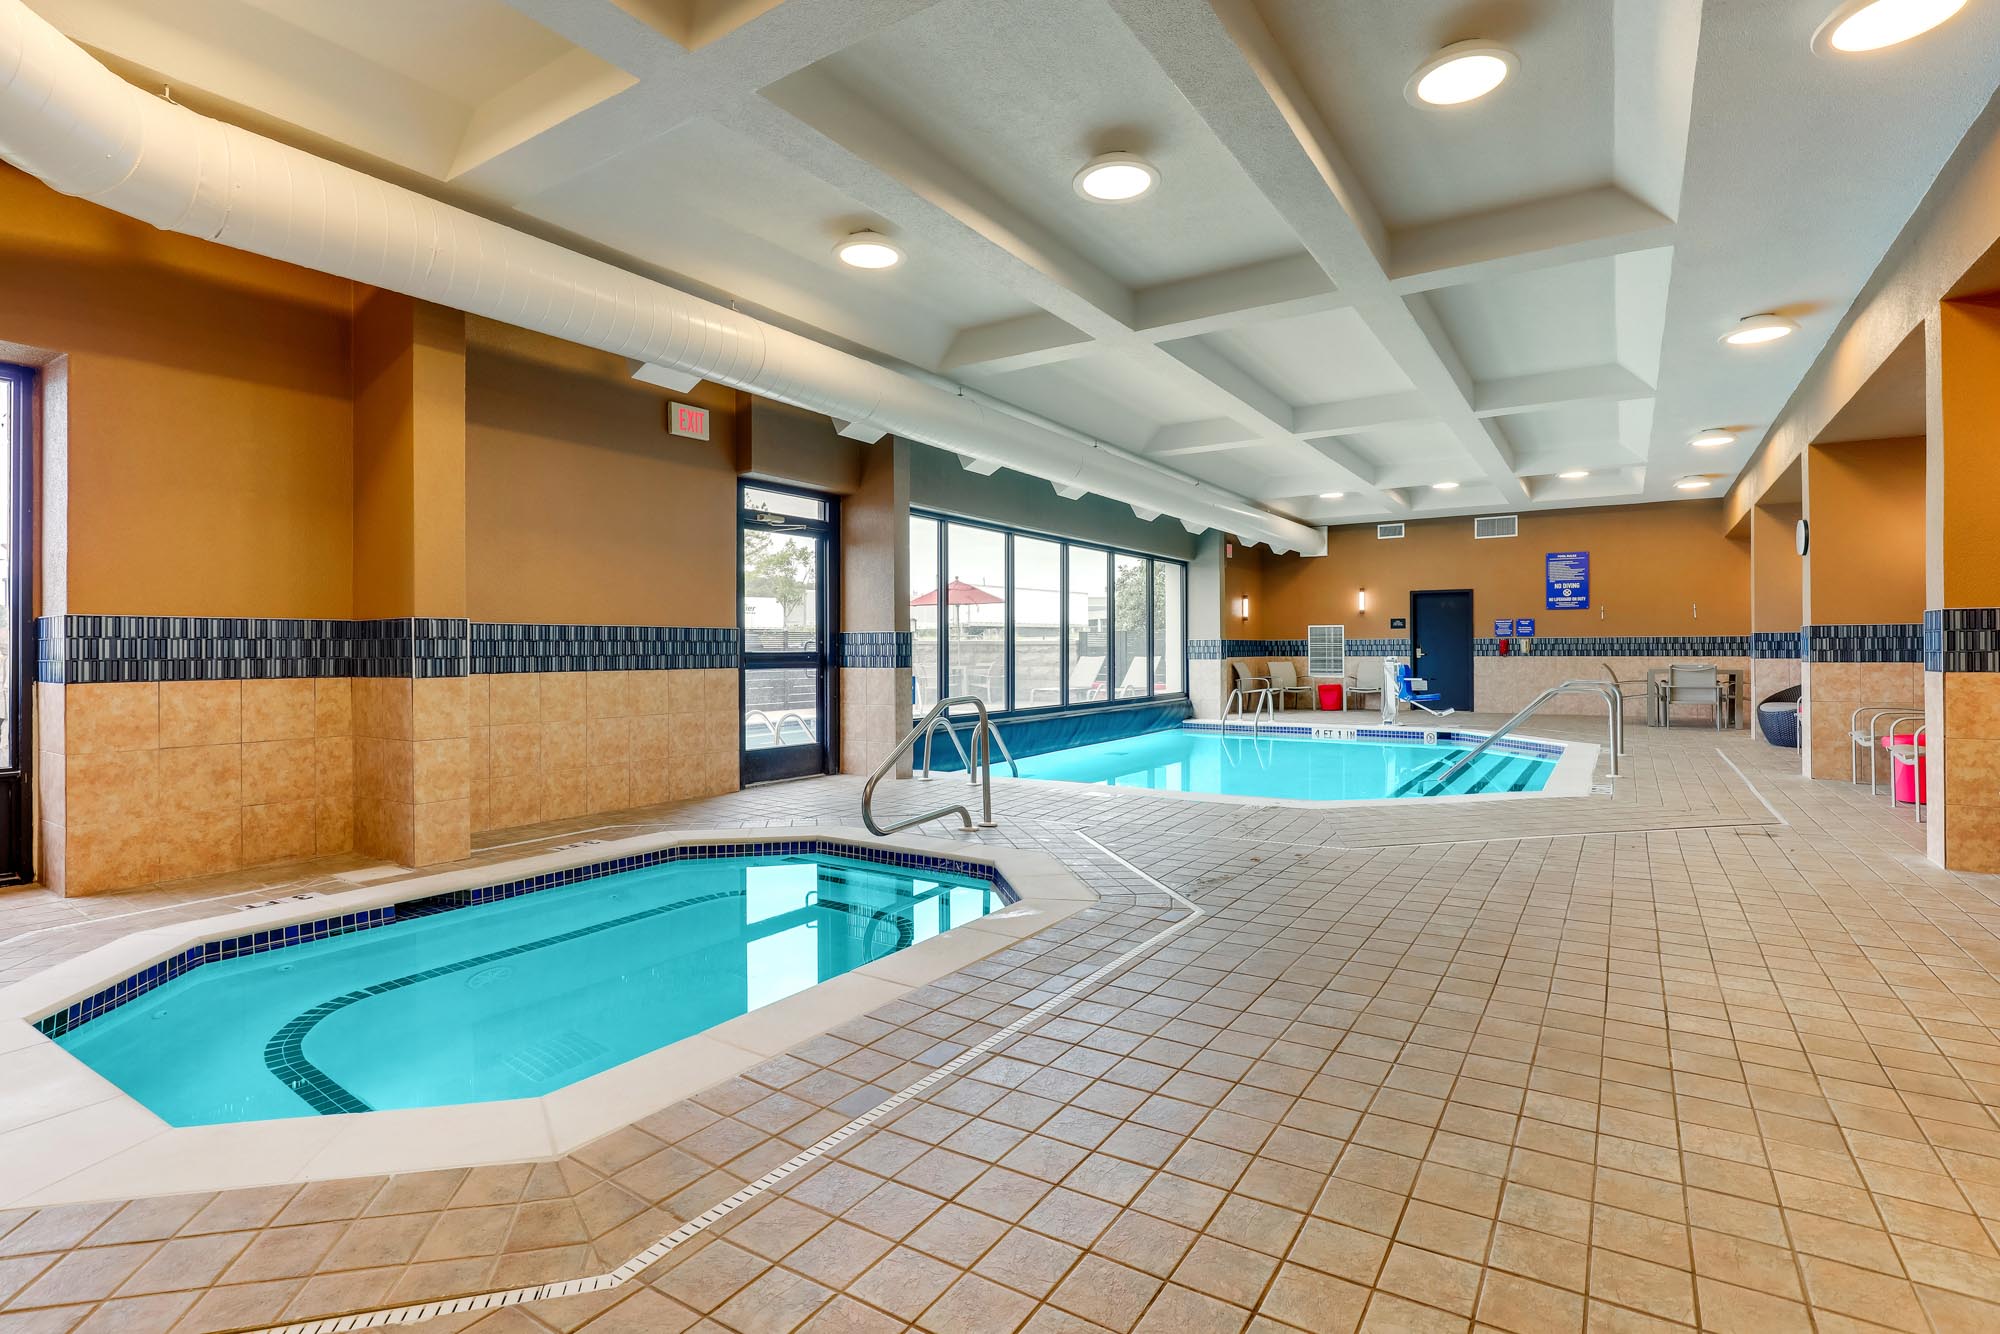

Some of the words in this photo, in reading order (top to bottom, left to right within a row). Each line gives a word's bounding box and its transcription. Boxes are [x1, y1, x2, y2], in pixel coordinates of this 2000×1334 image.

[679, 407, 705, 434] EXIT
[1315, 729, 1320, 738] 4
[1323, 730, 1333, 739] FT
[1346, 731, 1355, 740] IN
